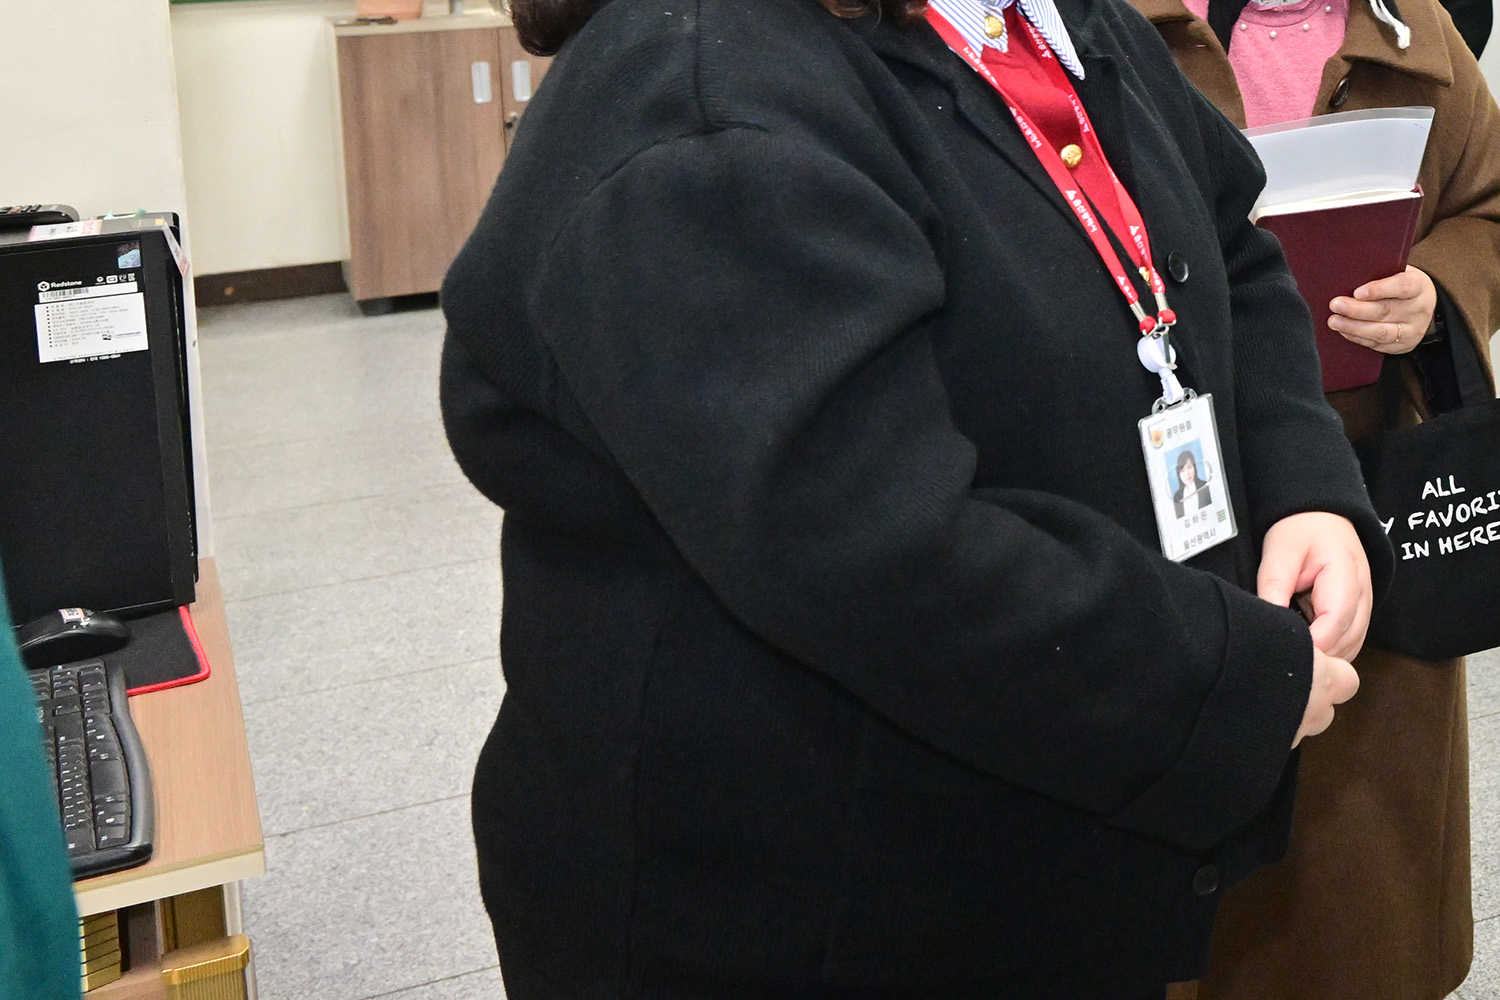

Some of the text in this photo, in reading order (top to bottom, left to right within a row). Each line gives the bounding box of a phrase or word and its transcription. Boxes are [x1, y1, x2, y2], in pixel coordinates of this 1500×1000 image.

[51, 280, 82, 289] Redstone
[1421, 474, 1466, 500] ALL
[1380, 516, 1395, 535] Y
[1400, 540, 1430, 561] IN
